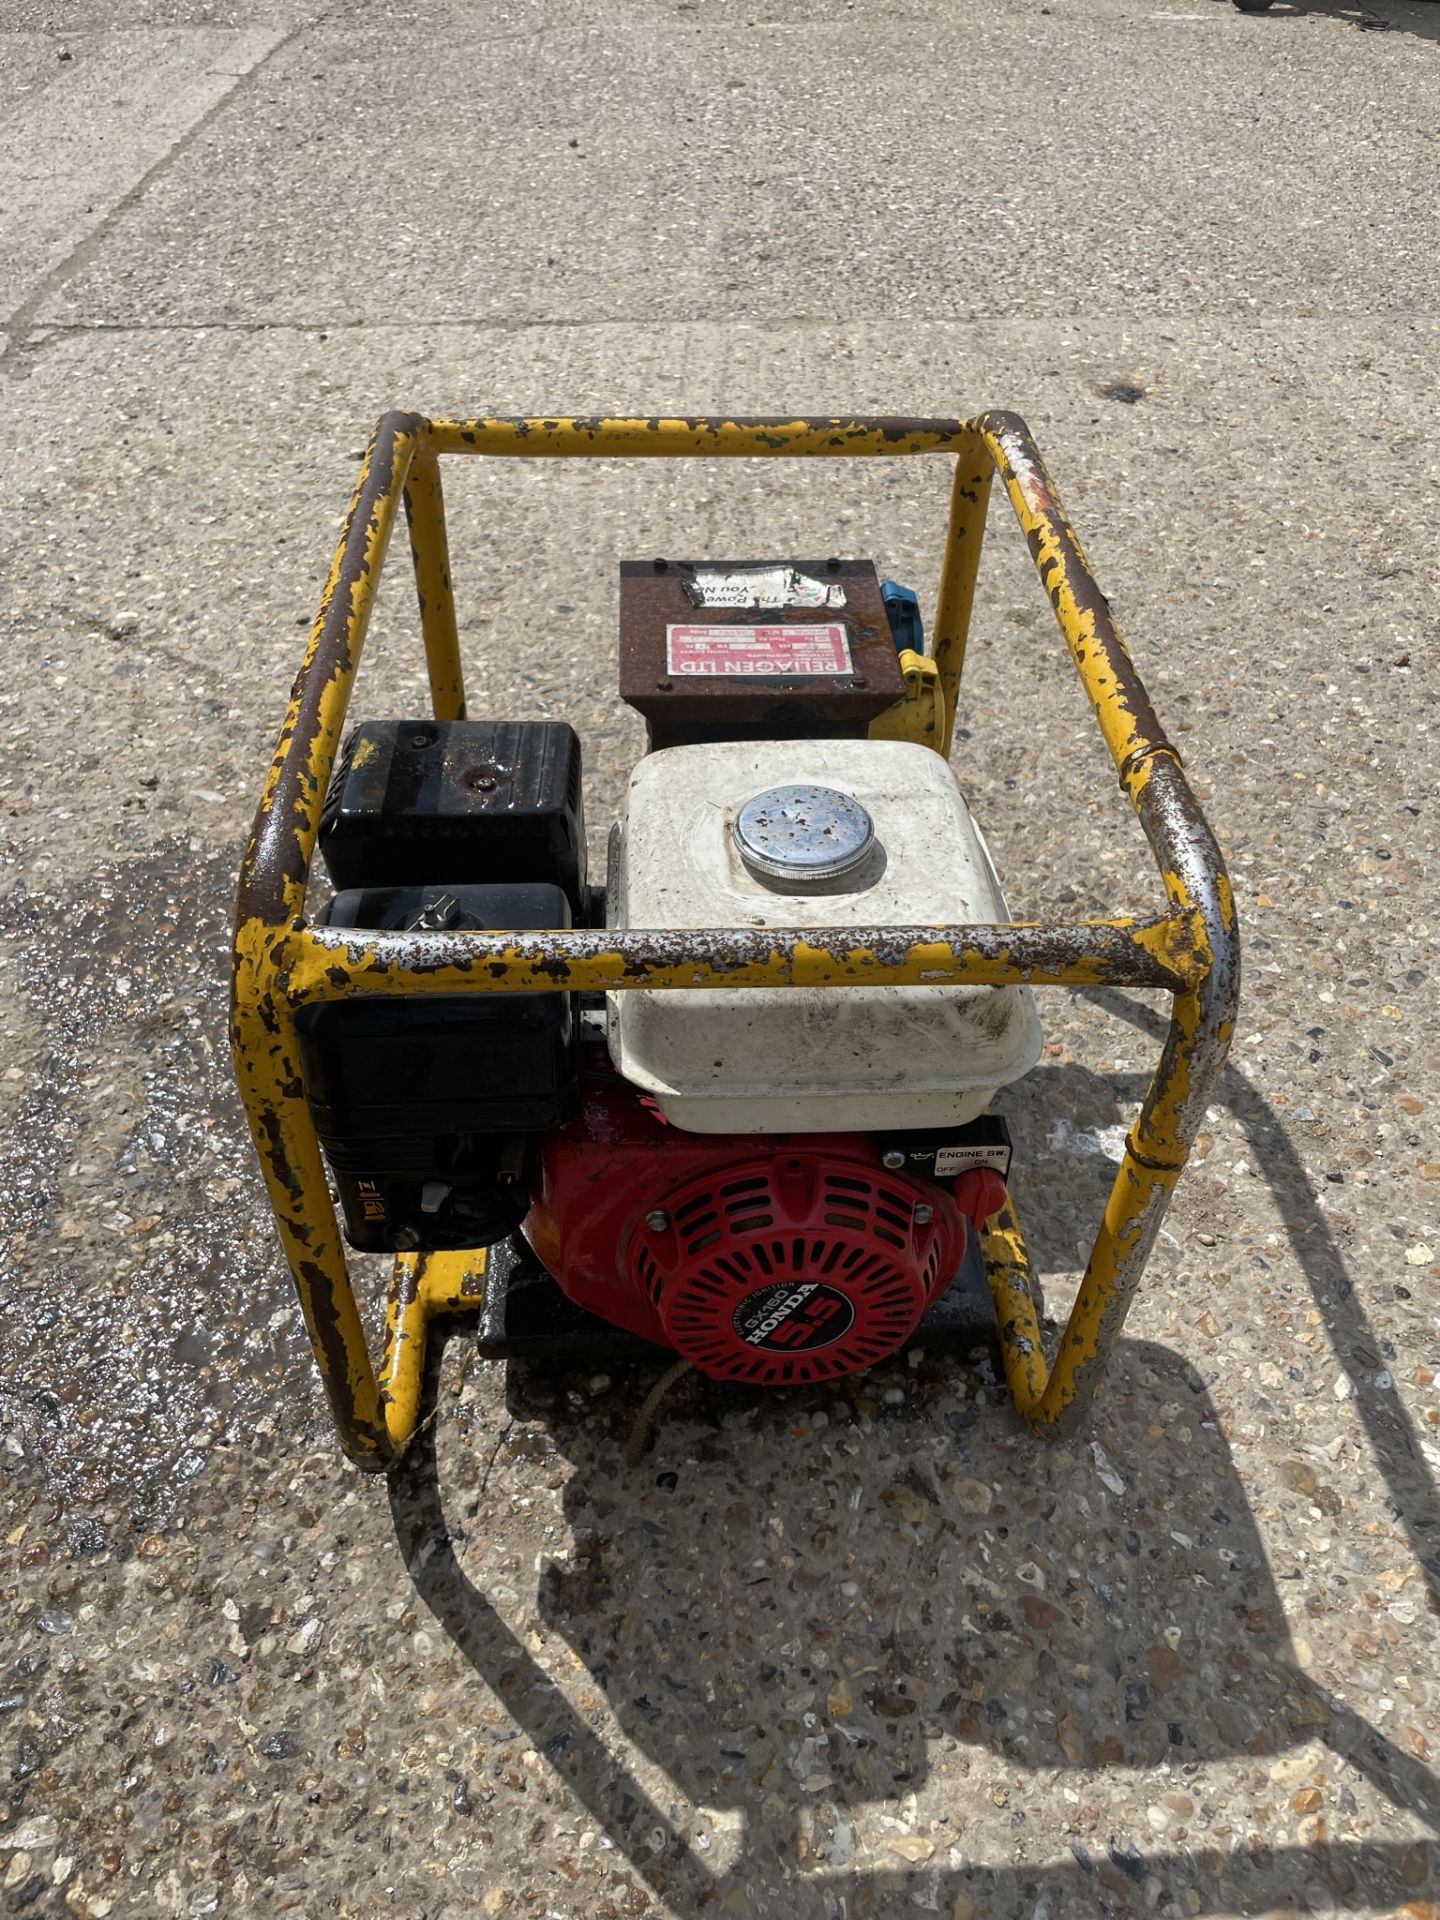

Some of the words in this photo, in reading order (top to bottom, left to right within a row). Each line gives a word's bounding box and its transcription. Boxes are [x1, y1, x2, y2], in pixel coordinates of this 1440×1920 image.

[680, 661, 717, 673] LTD
[725, 661, 839, 673] RELIAGEN
[938, 1151, 983, 1159] ENGINE
[752, 1282, 795, 1298] IGNITION
[744, 1289, 789, 1329] GX160
[745, 1283, 820, 1345] HONDA
[767, 1295, 843, 1347] 5.5
